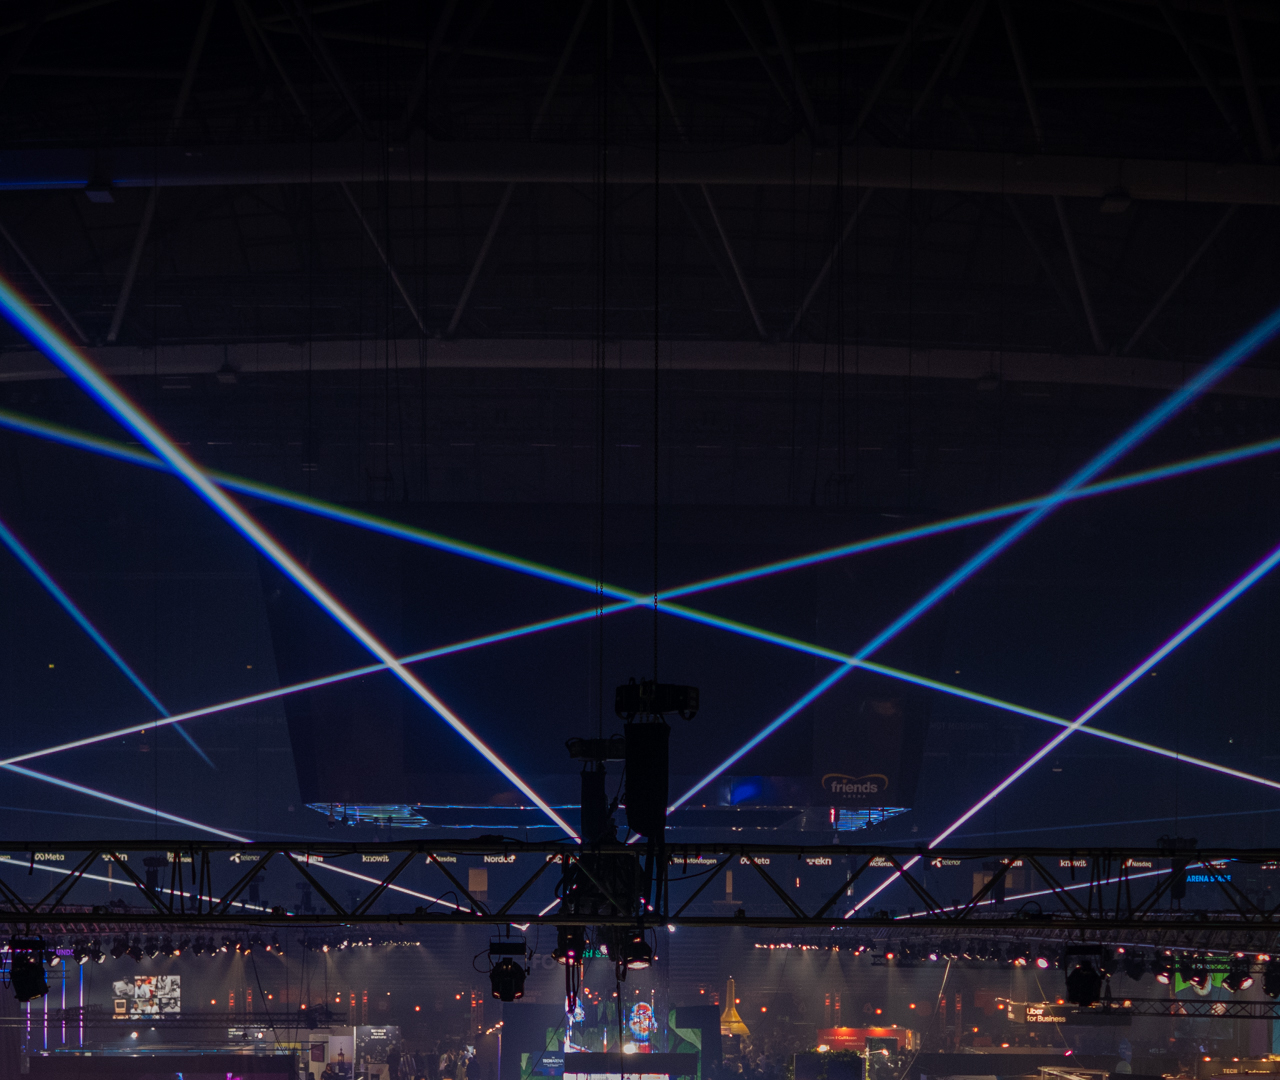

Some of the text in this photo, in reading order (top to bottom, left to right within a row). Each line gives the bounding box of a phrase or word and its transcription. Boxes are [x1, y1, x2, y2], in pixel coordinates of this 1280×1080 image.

[831, 779, 878, 793] friends
[45, 852, 65, 861] Meta
[240, 854, 261, 862] telenor
[361, 854, 390, 863] knowit
[1132, 861, 1152, 869] Nasdaq
[1186, 874, 1209, 883] ARENA
[1037, 1015, 1067, 1023] Business
